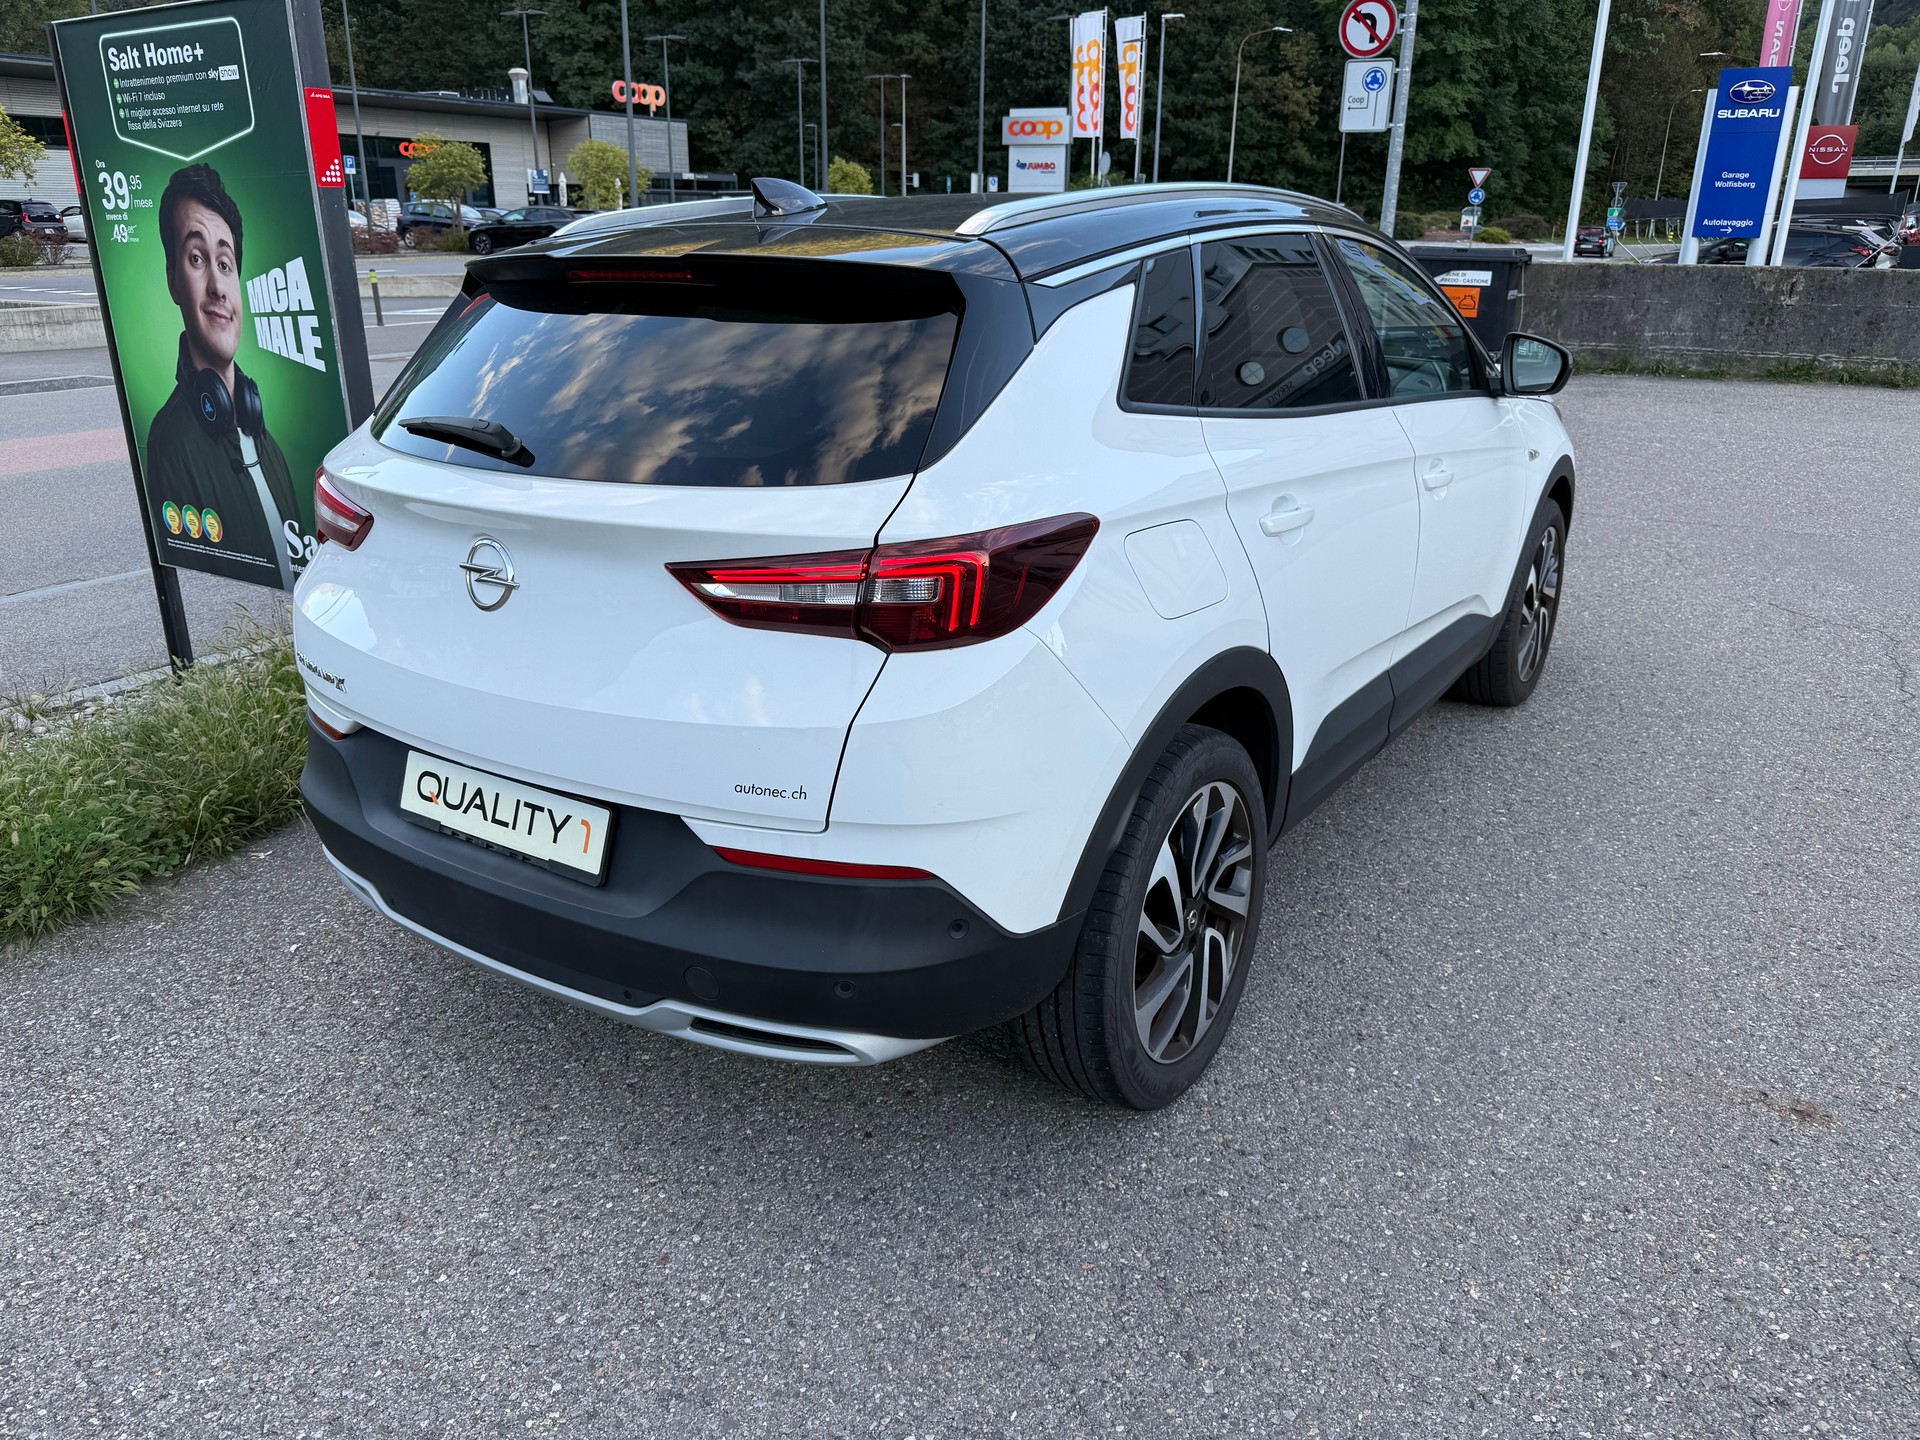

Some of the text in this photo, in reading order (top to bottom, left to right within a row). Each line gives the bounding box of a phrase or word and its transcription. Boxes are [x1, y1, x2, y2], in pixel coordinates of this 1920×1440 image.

[108, 42, 204, 71] Salt Home+
[119, 68, 237, 88] Intrattenimento premium con sky show
[122, 92, 138, 103] Wi-Fi
[144, 90, 166, 101] incluso
[612, 80, 666, 112] coop
[1347, 96, 1365, 105] Coop
[125, 102, 224, 120] Il miglior accesso internet su rete
[1717, 108, 1780, 118] SUBARU
[128, 117, 182, 130] fissa della Svizzera
[1008, 120, 1063, 140] coop
[95, 160, 106, 169] Ora
[1027, 162, 1056, 170] JUMBO
[1721, 171, 1750, 179] Garage
[1714, 181, 1756, 189] Wolfisberg
[105, 212, 128, 220] invece di
[1702, 218, 1754, 228] Autolavaggio
[246, 256, 315, 314] MICA
[254, 315, 327, 373] MALE
[283, 519, 318, 561] Sa
[734, 783, 807, 800] autonec.ch
[416, 770, 592, 854] QUALITY 1
